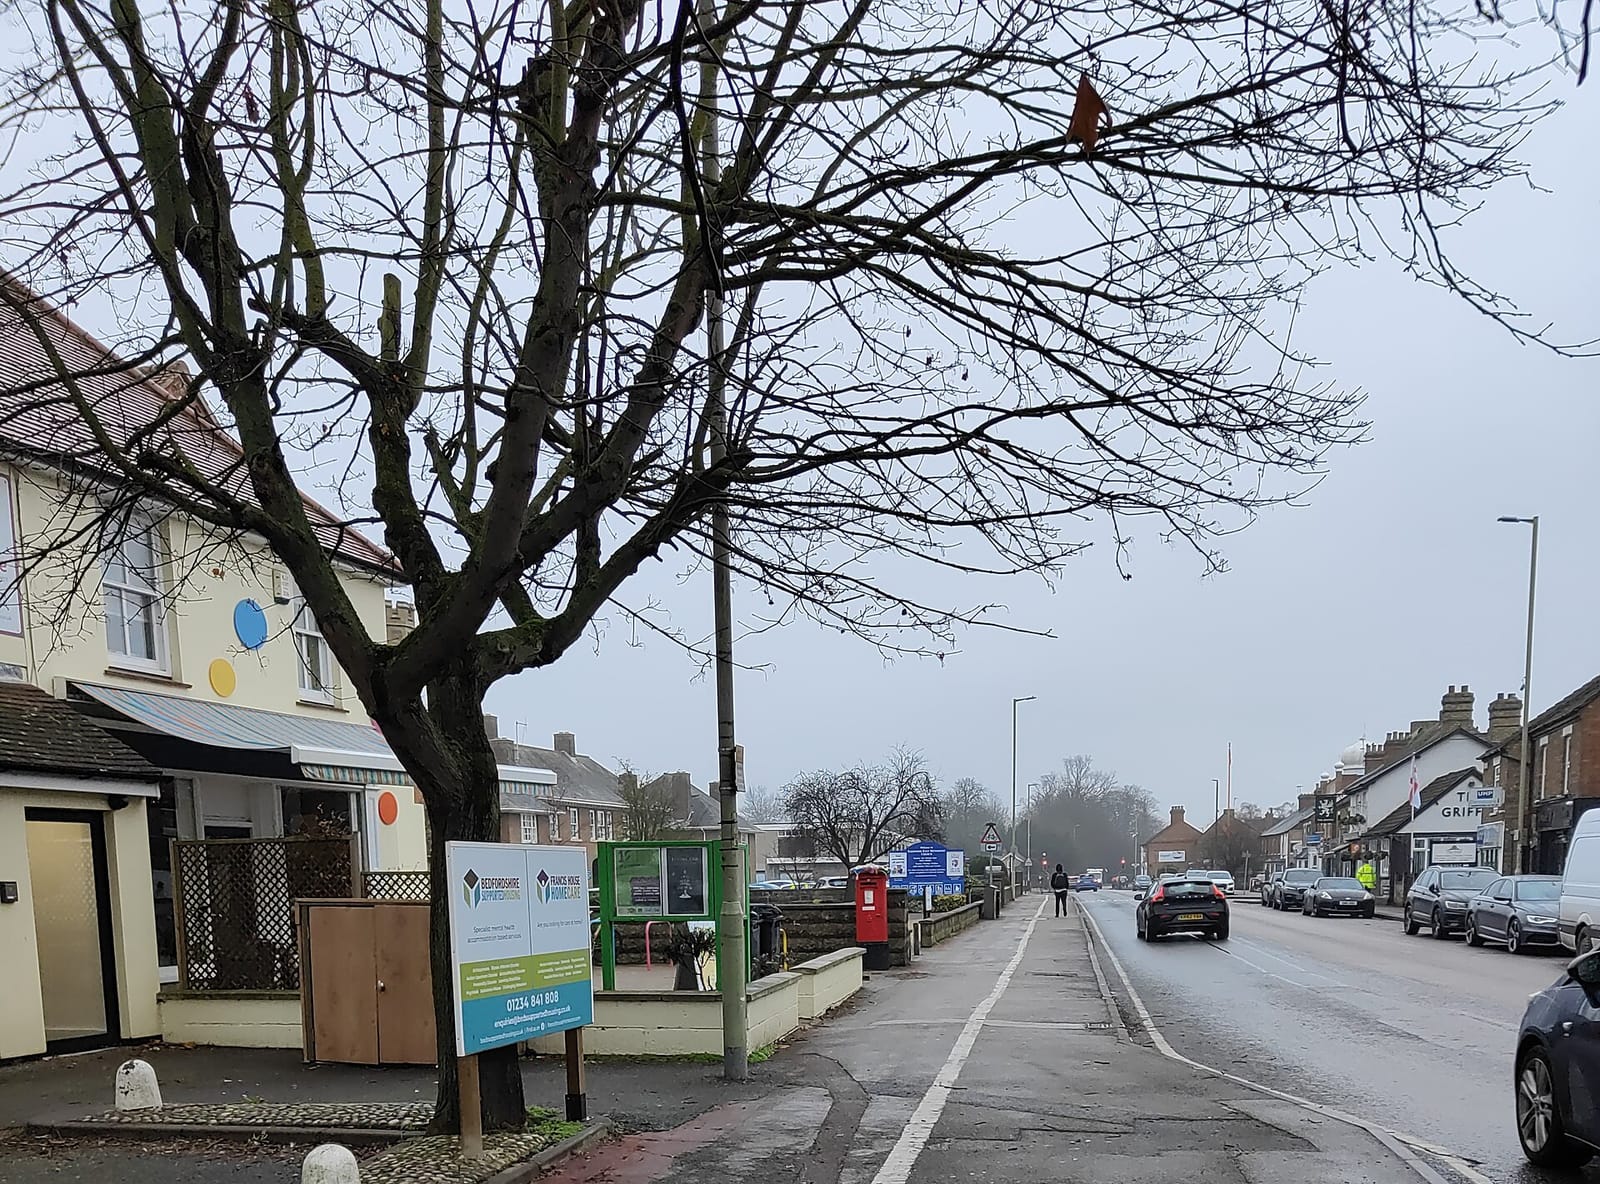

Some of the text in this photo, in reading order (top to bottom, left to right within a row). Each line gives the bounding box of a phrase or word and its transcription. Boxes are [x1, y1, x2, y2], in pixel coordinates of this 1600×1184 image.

[481, 877, 520, 890] BEDFORDSHIRE
[550, 875, 581, 886] FRANCIS HOUSE
[551, 886, 581, 900] HOMECARE
[506, 990, 559, 1012] 01234 841 808
